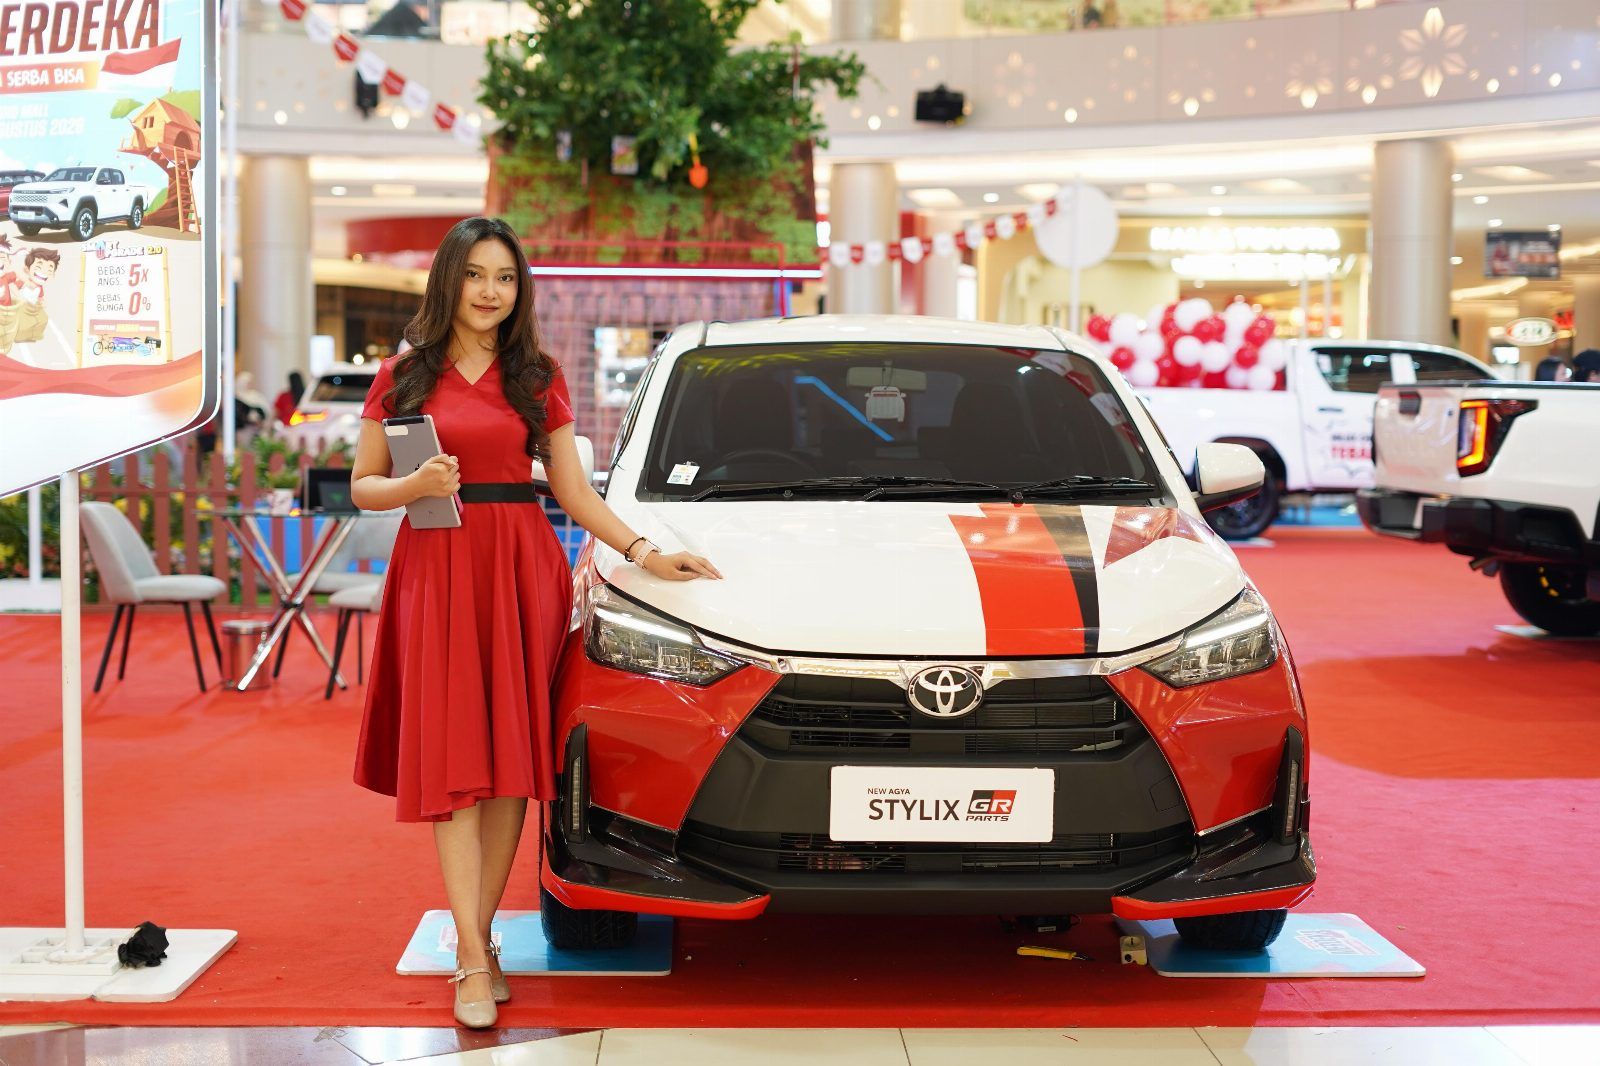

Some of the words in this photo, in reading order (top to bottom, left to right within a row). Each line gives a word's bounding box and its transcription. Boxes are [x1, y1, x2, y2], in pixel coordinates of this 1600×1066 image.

[7, 68, 49, 87] SERBA
[54, 67, 84, 84] BISA
[97, 265, 126, 276] BEBAS
[97, 293, 121, 303] BEBAS
[96, 303, 124, 312] BUNGA
[868, 799, 960, 821] STYLIX
[968, 798, 1013, 813] GR
